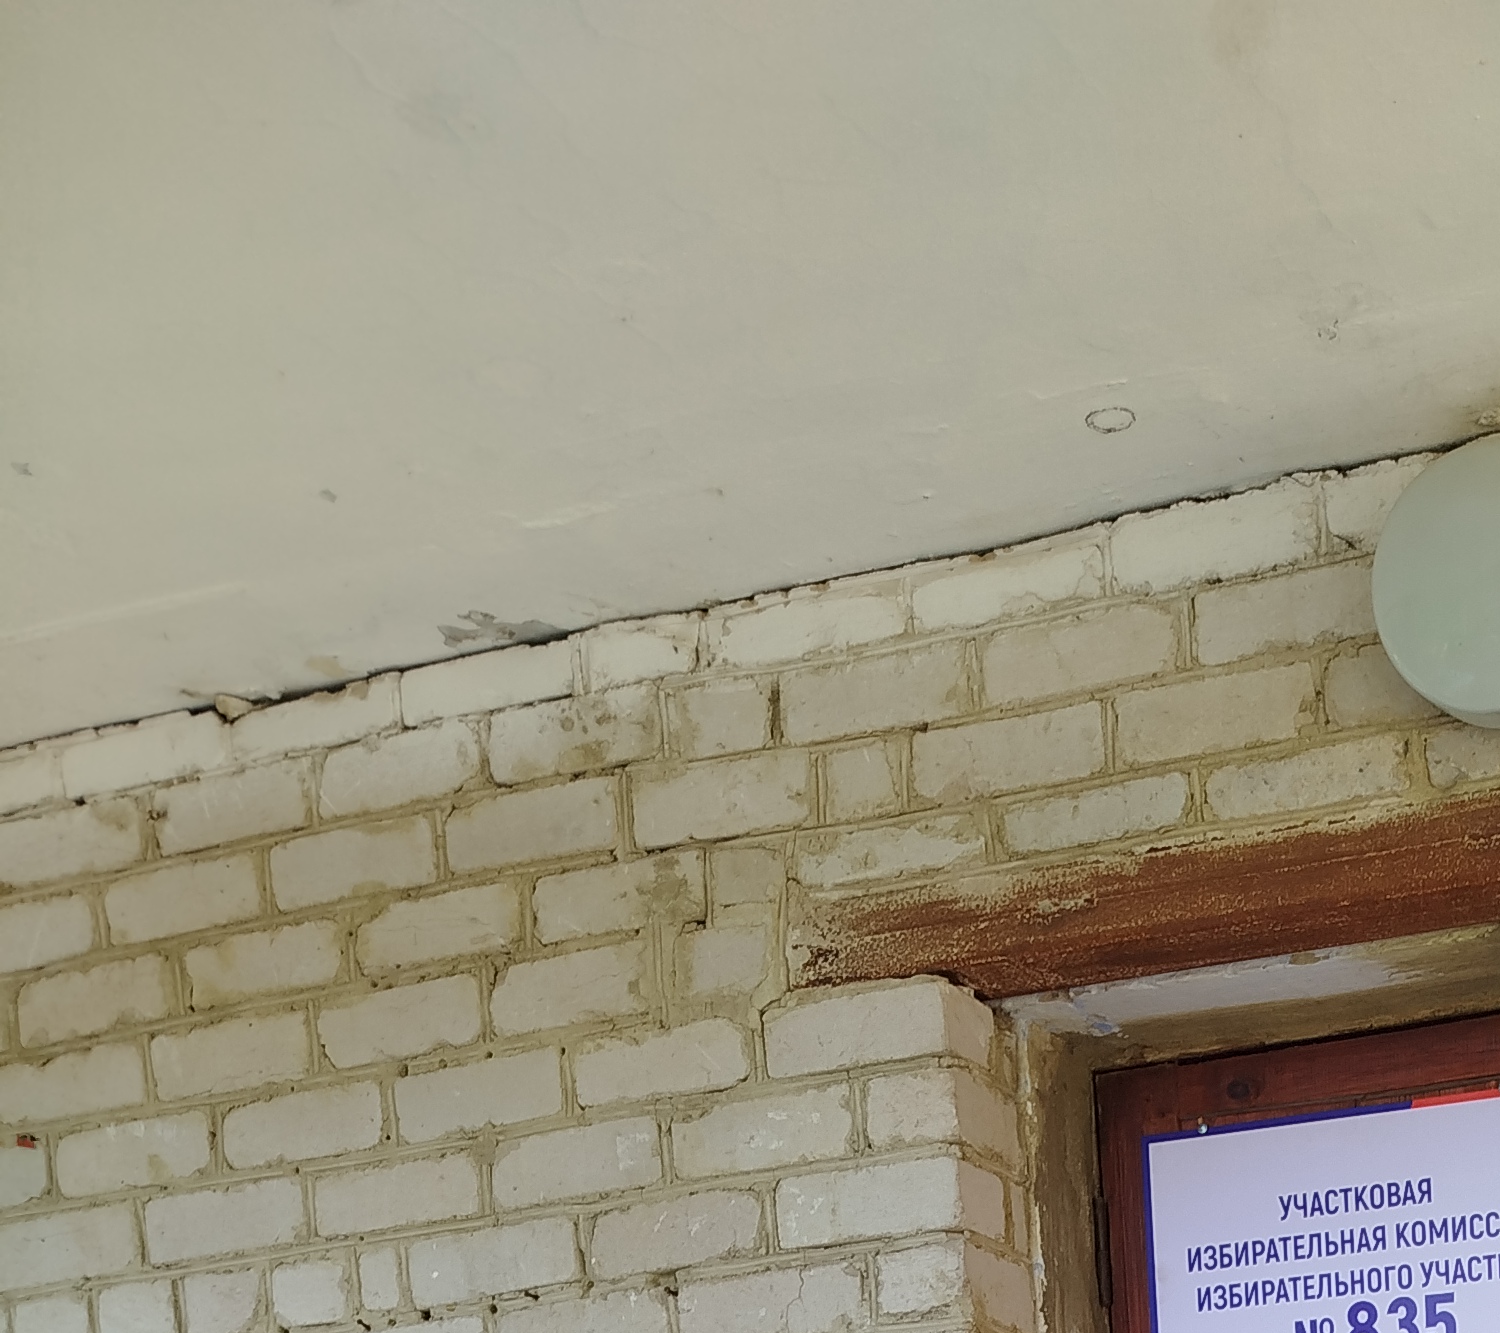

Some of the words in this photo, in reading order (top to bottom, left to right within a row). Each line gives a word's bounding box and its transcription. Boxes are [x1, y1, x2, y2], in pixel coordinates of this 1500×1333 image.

[1278, 1177, 1433, 1221] УЧАСТКОВАЯ
[1187, 1225, 1387, 1273] ИЗБИРАТЕЛЬНАЯ
[1196, 1264, 1413, 1312] ИЗБИРАТЕЛЬНОГО
